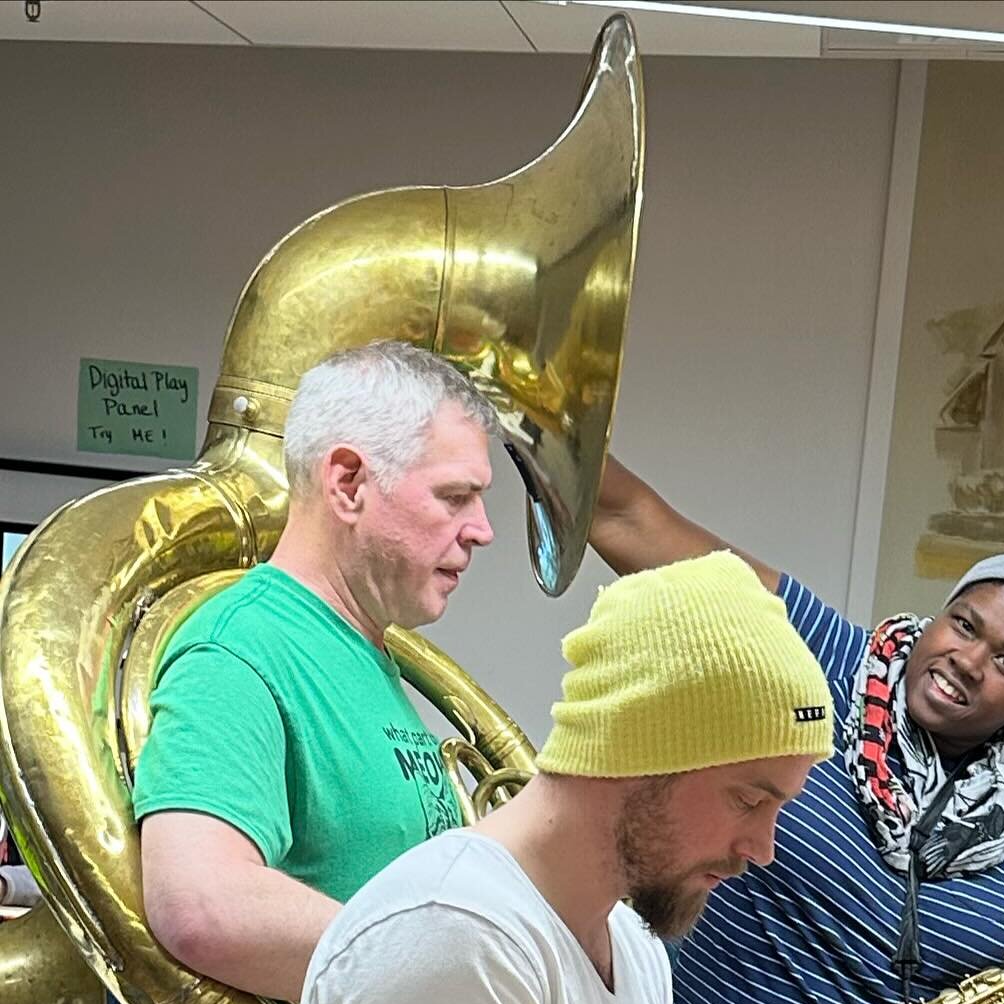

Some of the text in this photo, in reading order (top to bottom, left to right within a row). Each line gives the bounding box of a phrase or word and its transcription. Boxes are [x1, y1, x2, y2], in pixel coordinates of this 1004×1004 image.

[88, 364, 189, 404] Digital Play
[101, 397, 159, 417] Panel
[88, 425, 113, 444] Try
[382, 721, 413, 745] what
